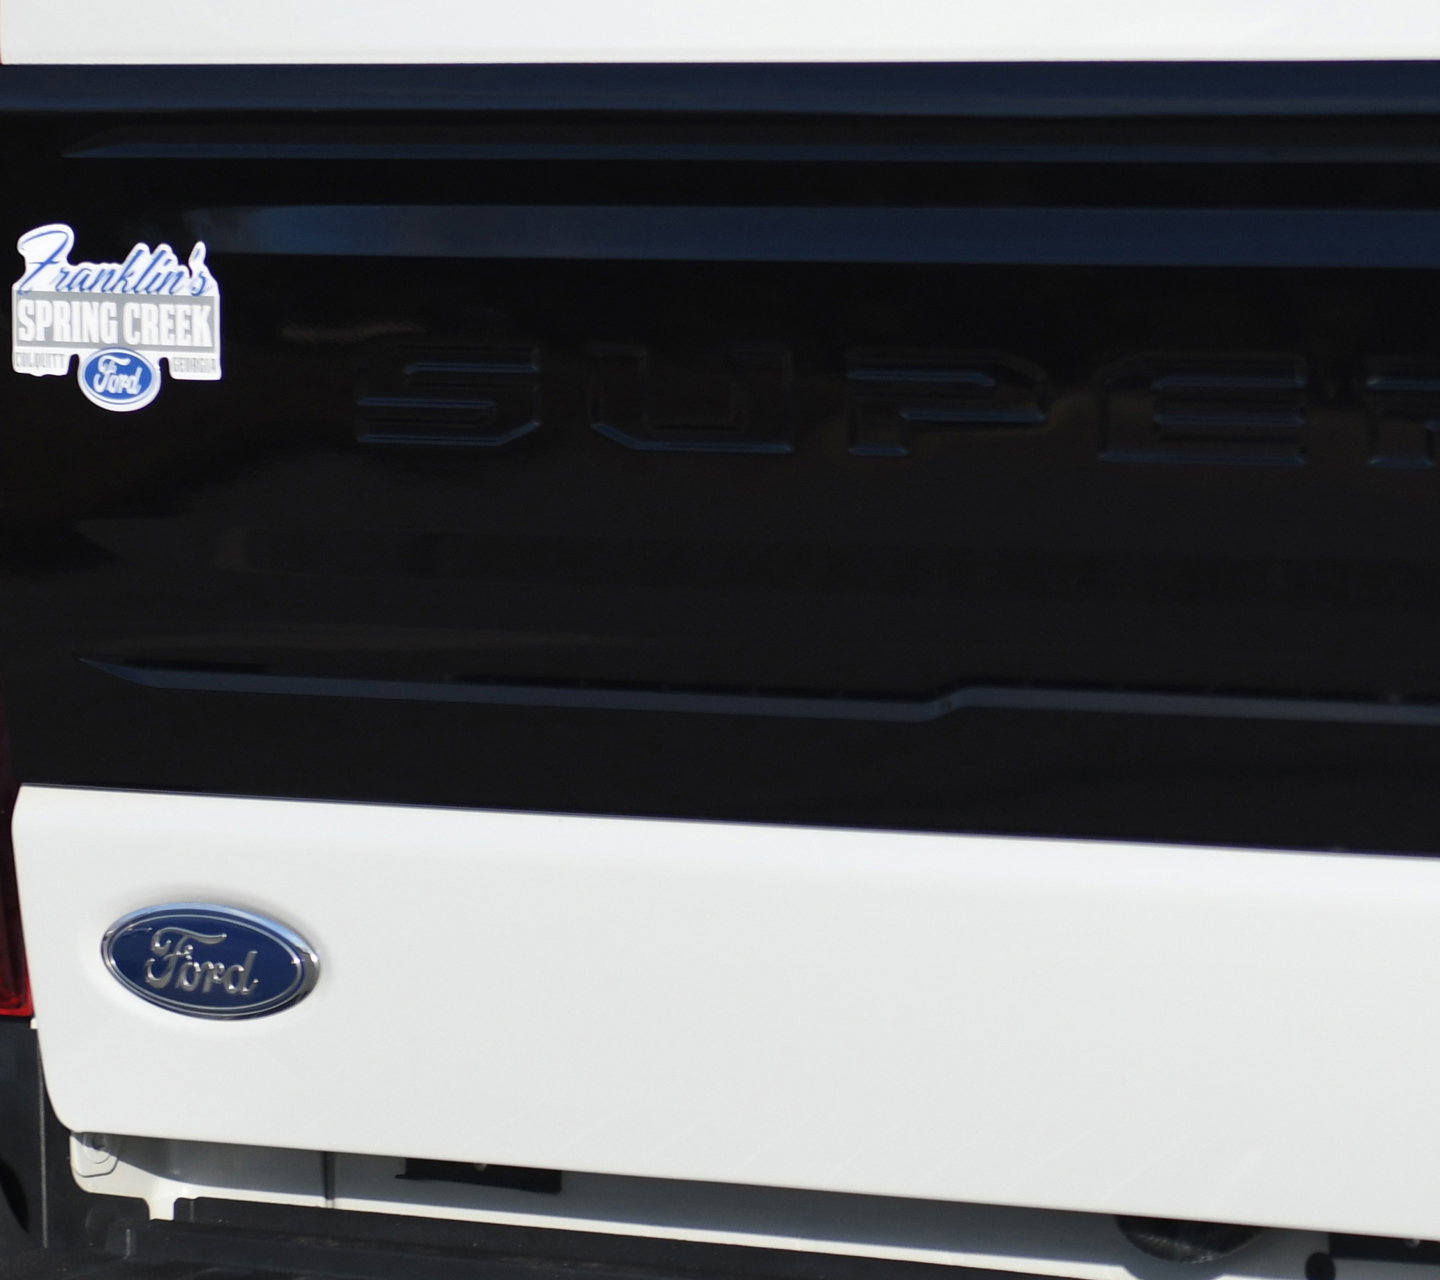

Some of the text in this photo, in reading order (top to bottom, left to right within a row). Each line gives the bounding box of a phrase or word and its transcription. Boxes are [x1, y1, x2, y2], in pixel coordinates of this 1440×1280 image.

[17, 230, 210, 296] Franklin's
[17, 298, 212, 348] SPRING CREEK
[93, 355, 143, 395] Ford
[143, 925, 259, 996] Ford
